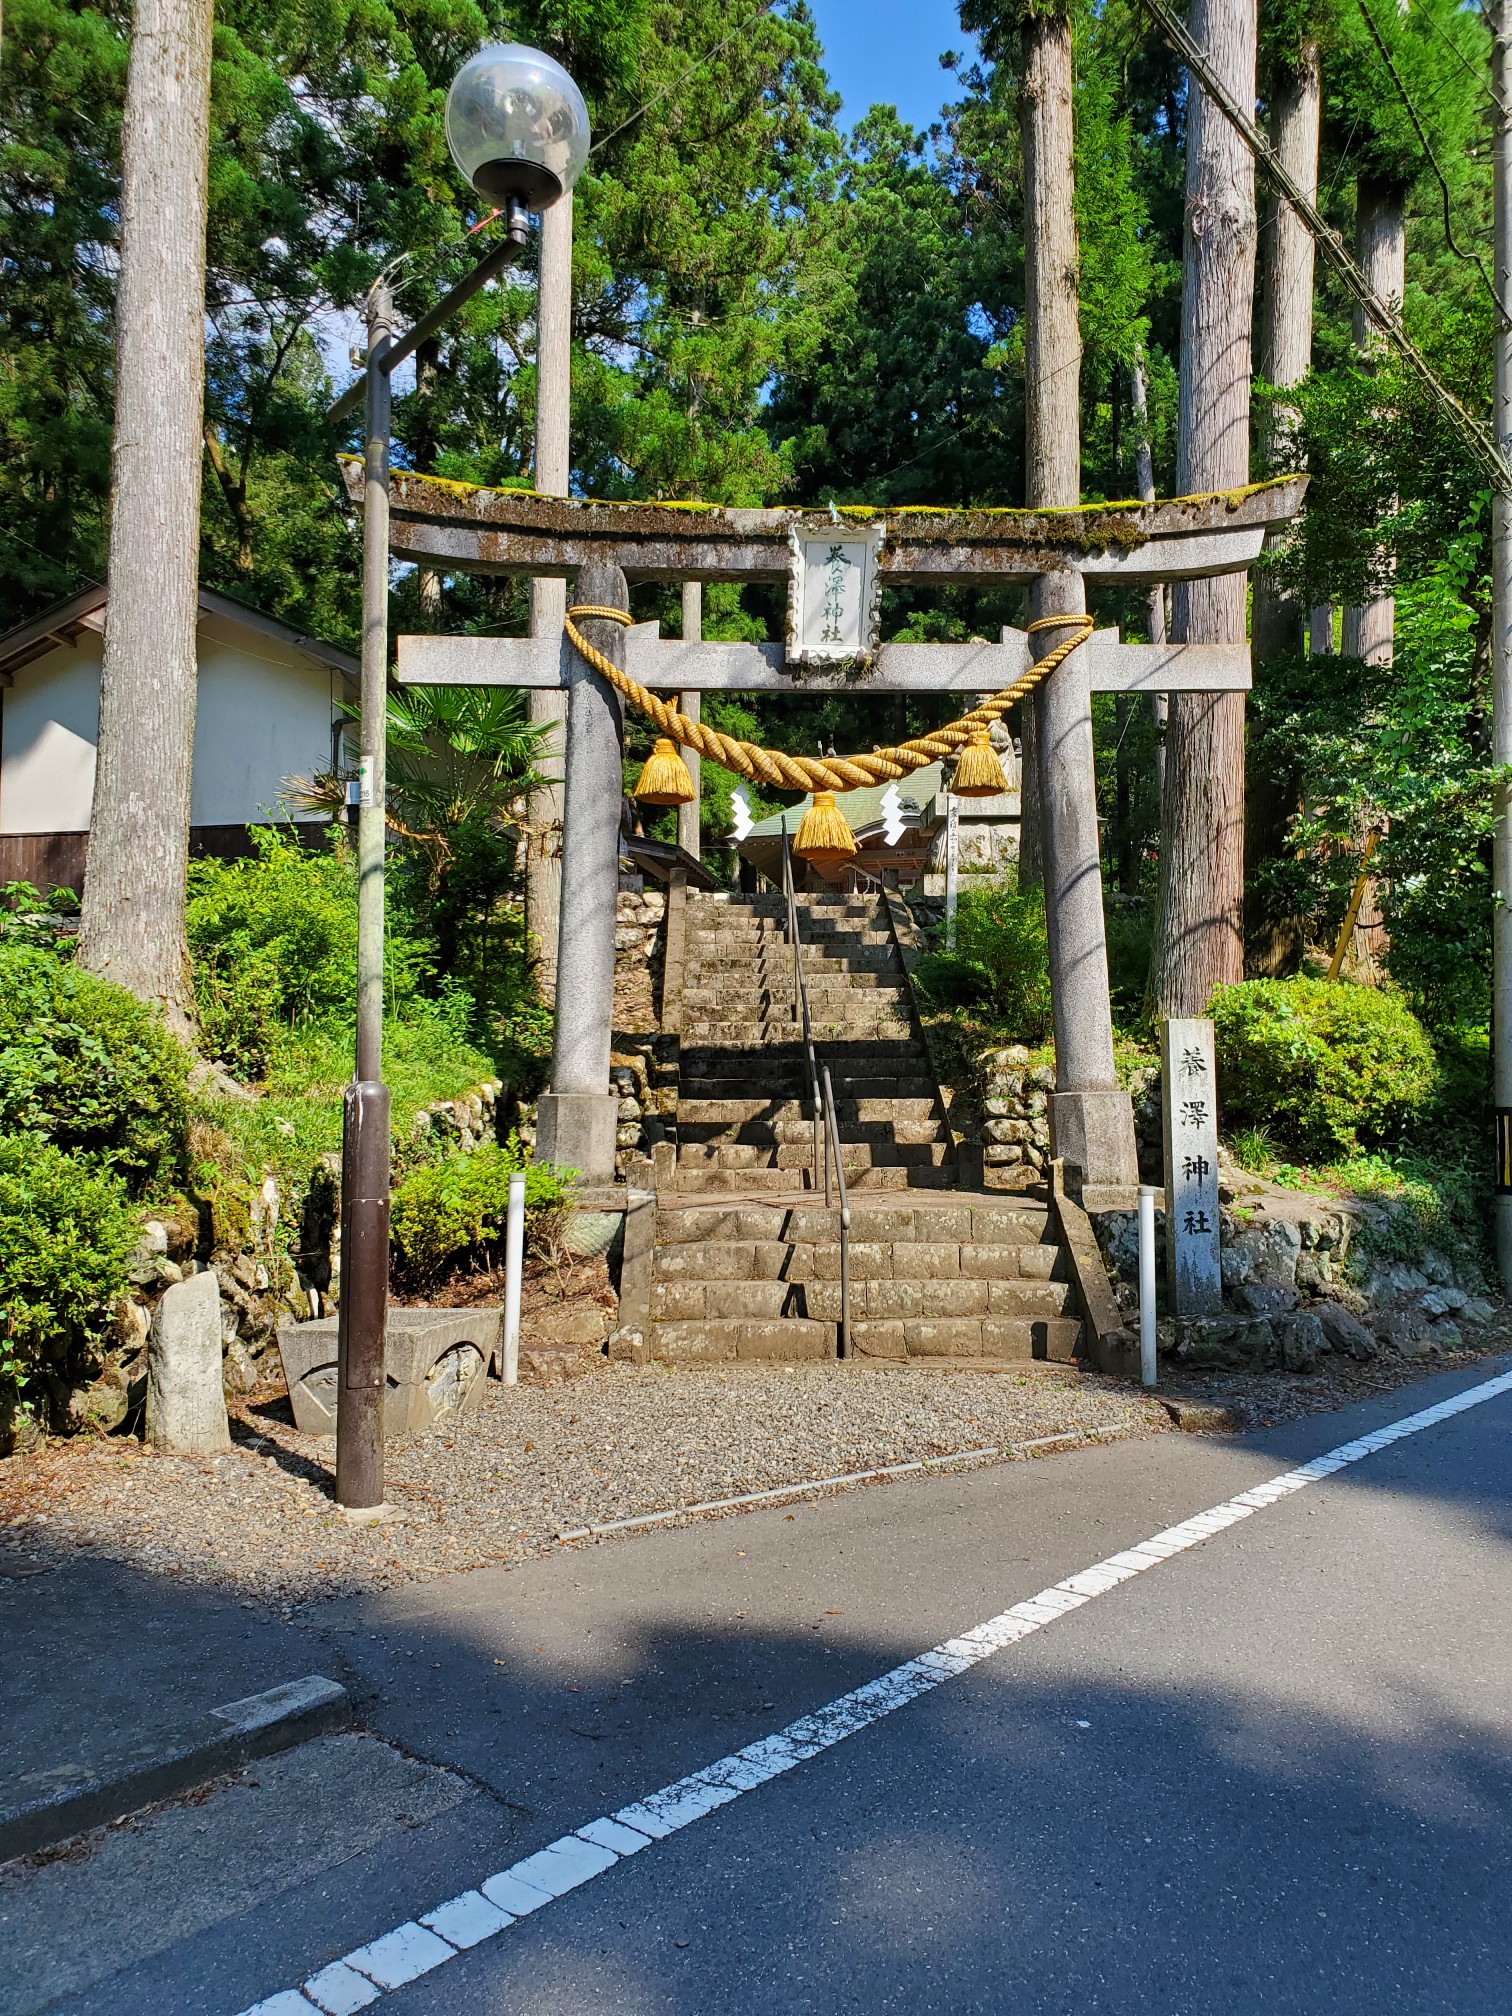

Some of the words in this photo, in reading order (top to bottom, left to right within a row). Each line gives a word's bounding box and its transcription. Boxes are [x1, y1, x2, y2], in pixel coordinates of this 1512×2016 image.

[821, 545, 852, 643] 養澤神社
[1178, 1046, 1212, 1236] 養澤神社
